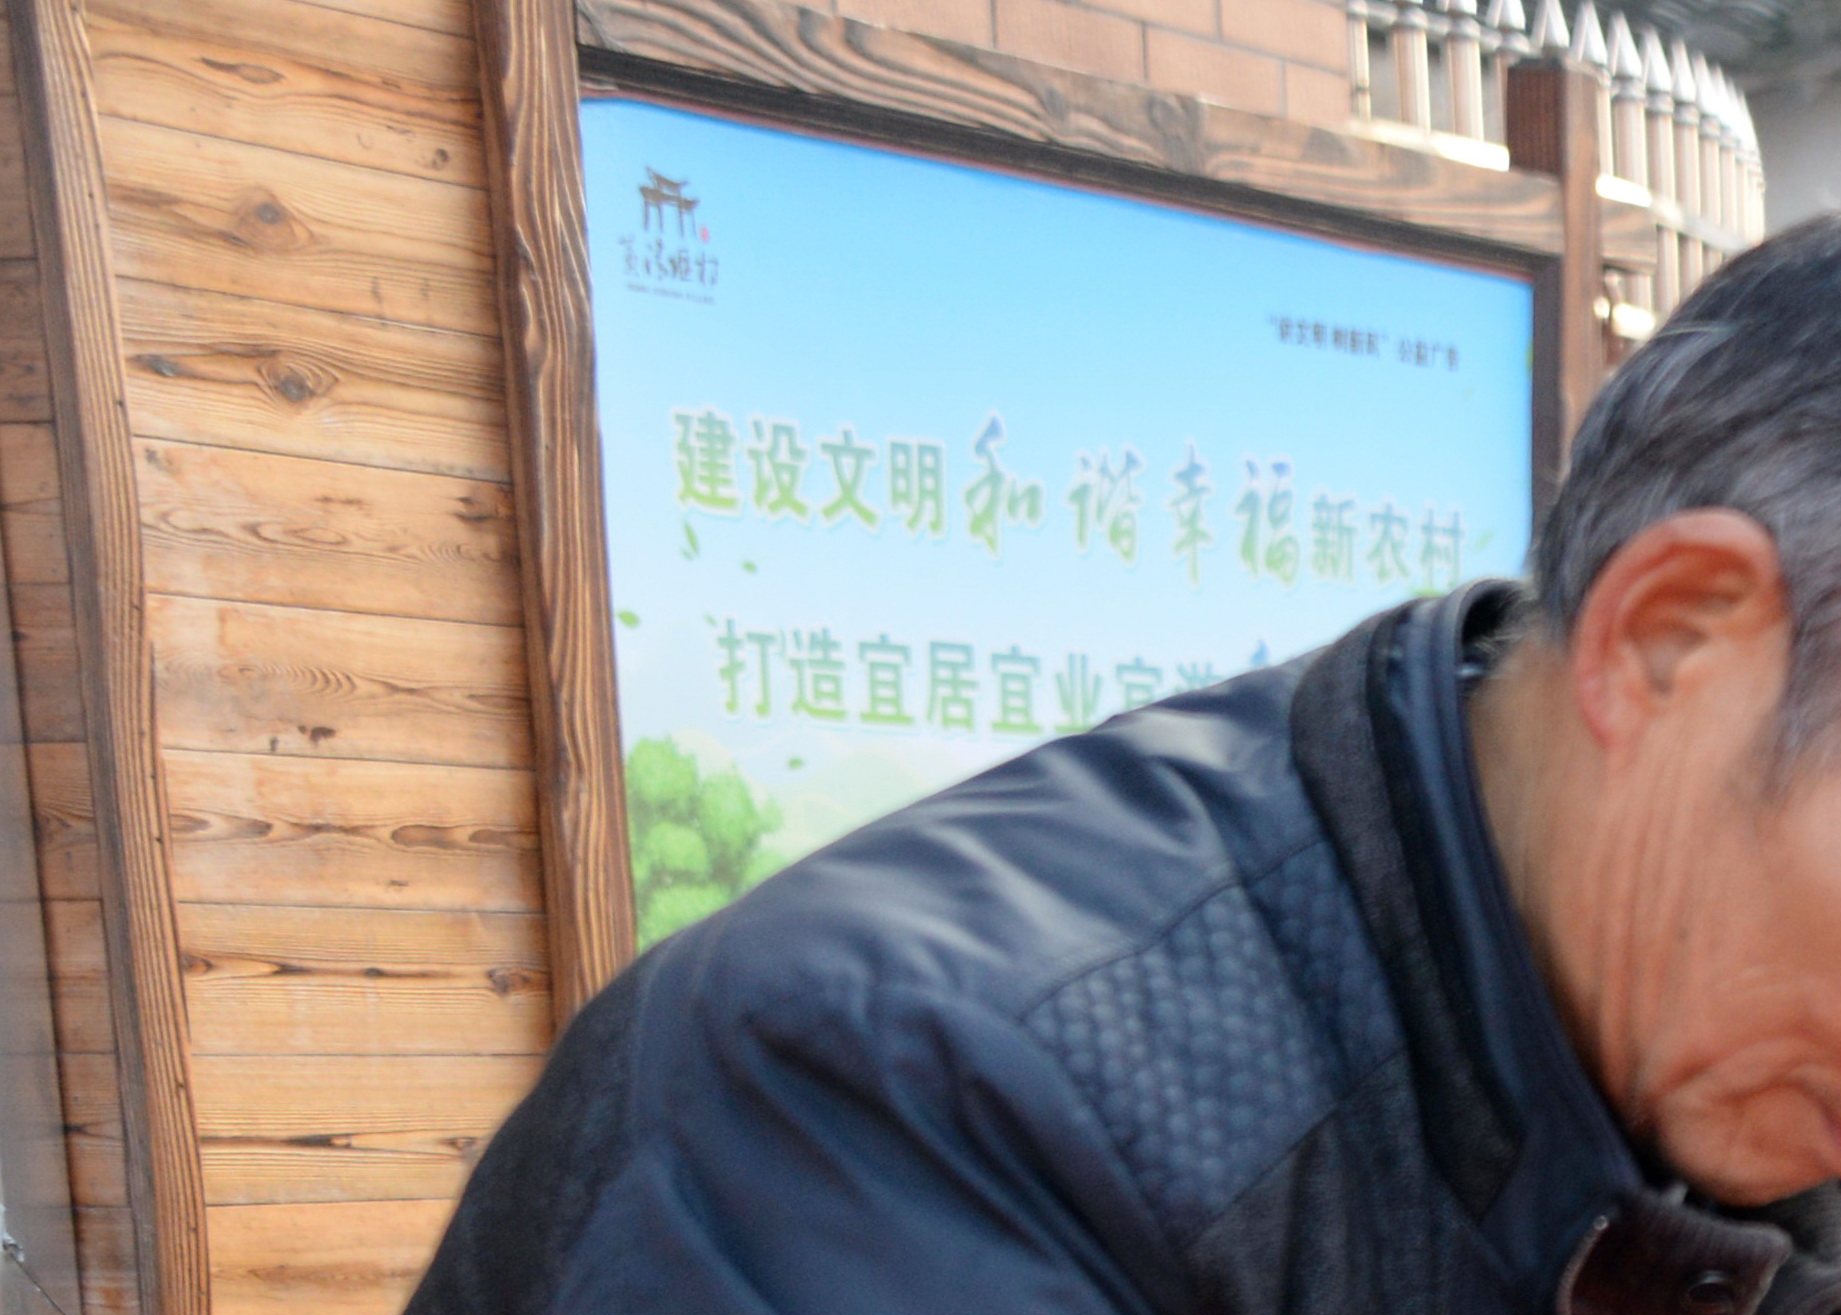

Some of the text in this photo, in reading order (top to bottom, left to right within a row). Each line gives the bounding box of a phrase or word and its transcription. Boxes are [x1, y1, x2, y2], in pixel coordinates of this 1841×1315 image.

[674, 409, 1466, 589] 建设文明和谐幸福新农村
